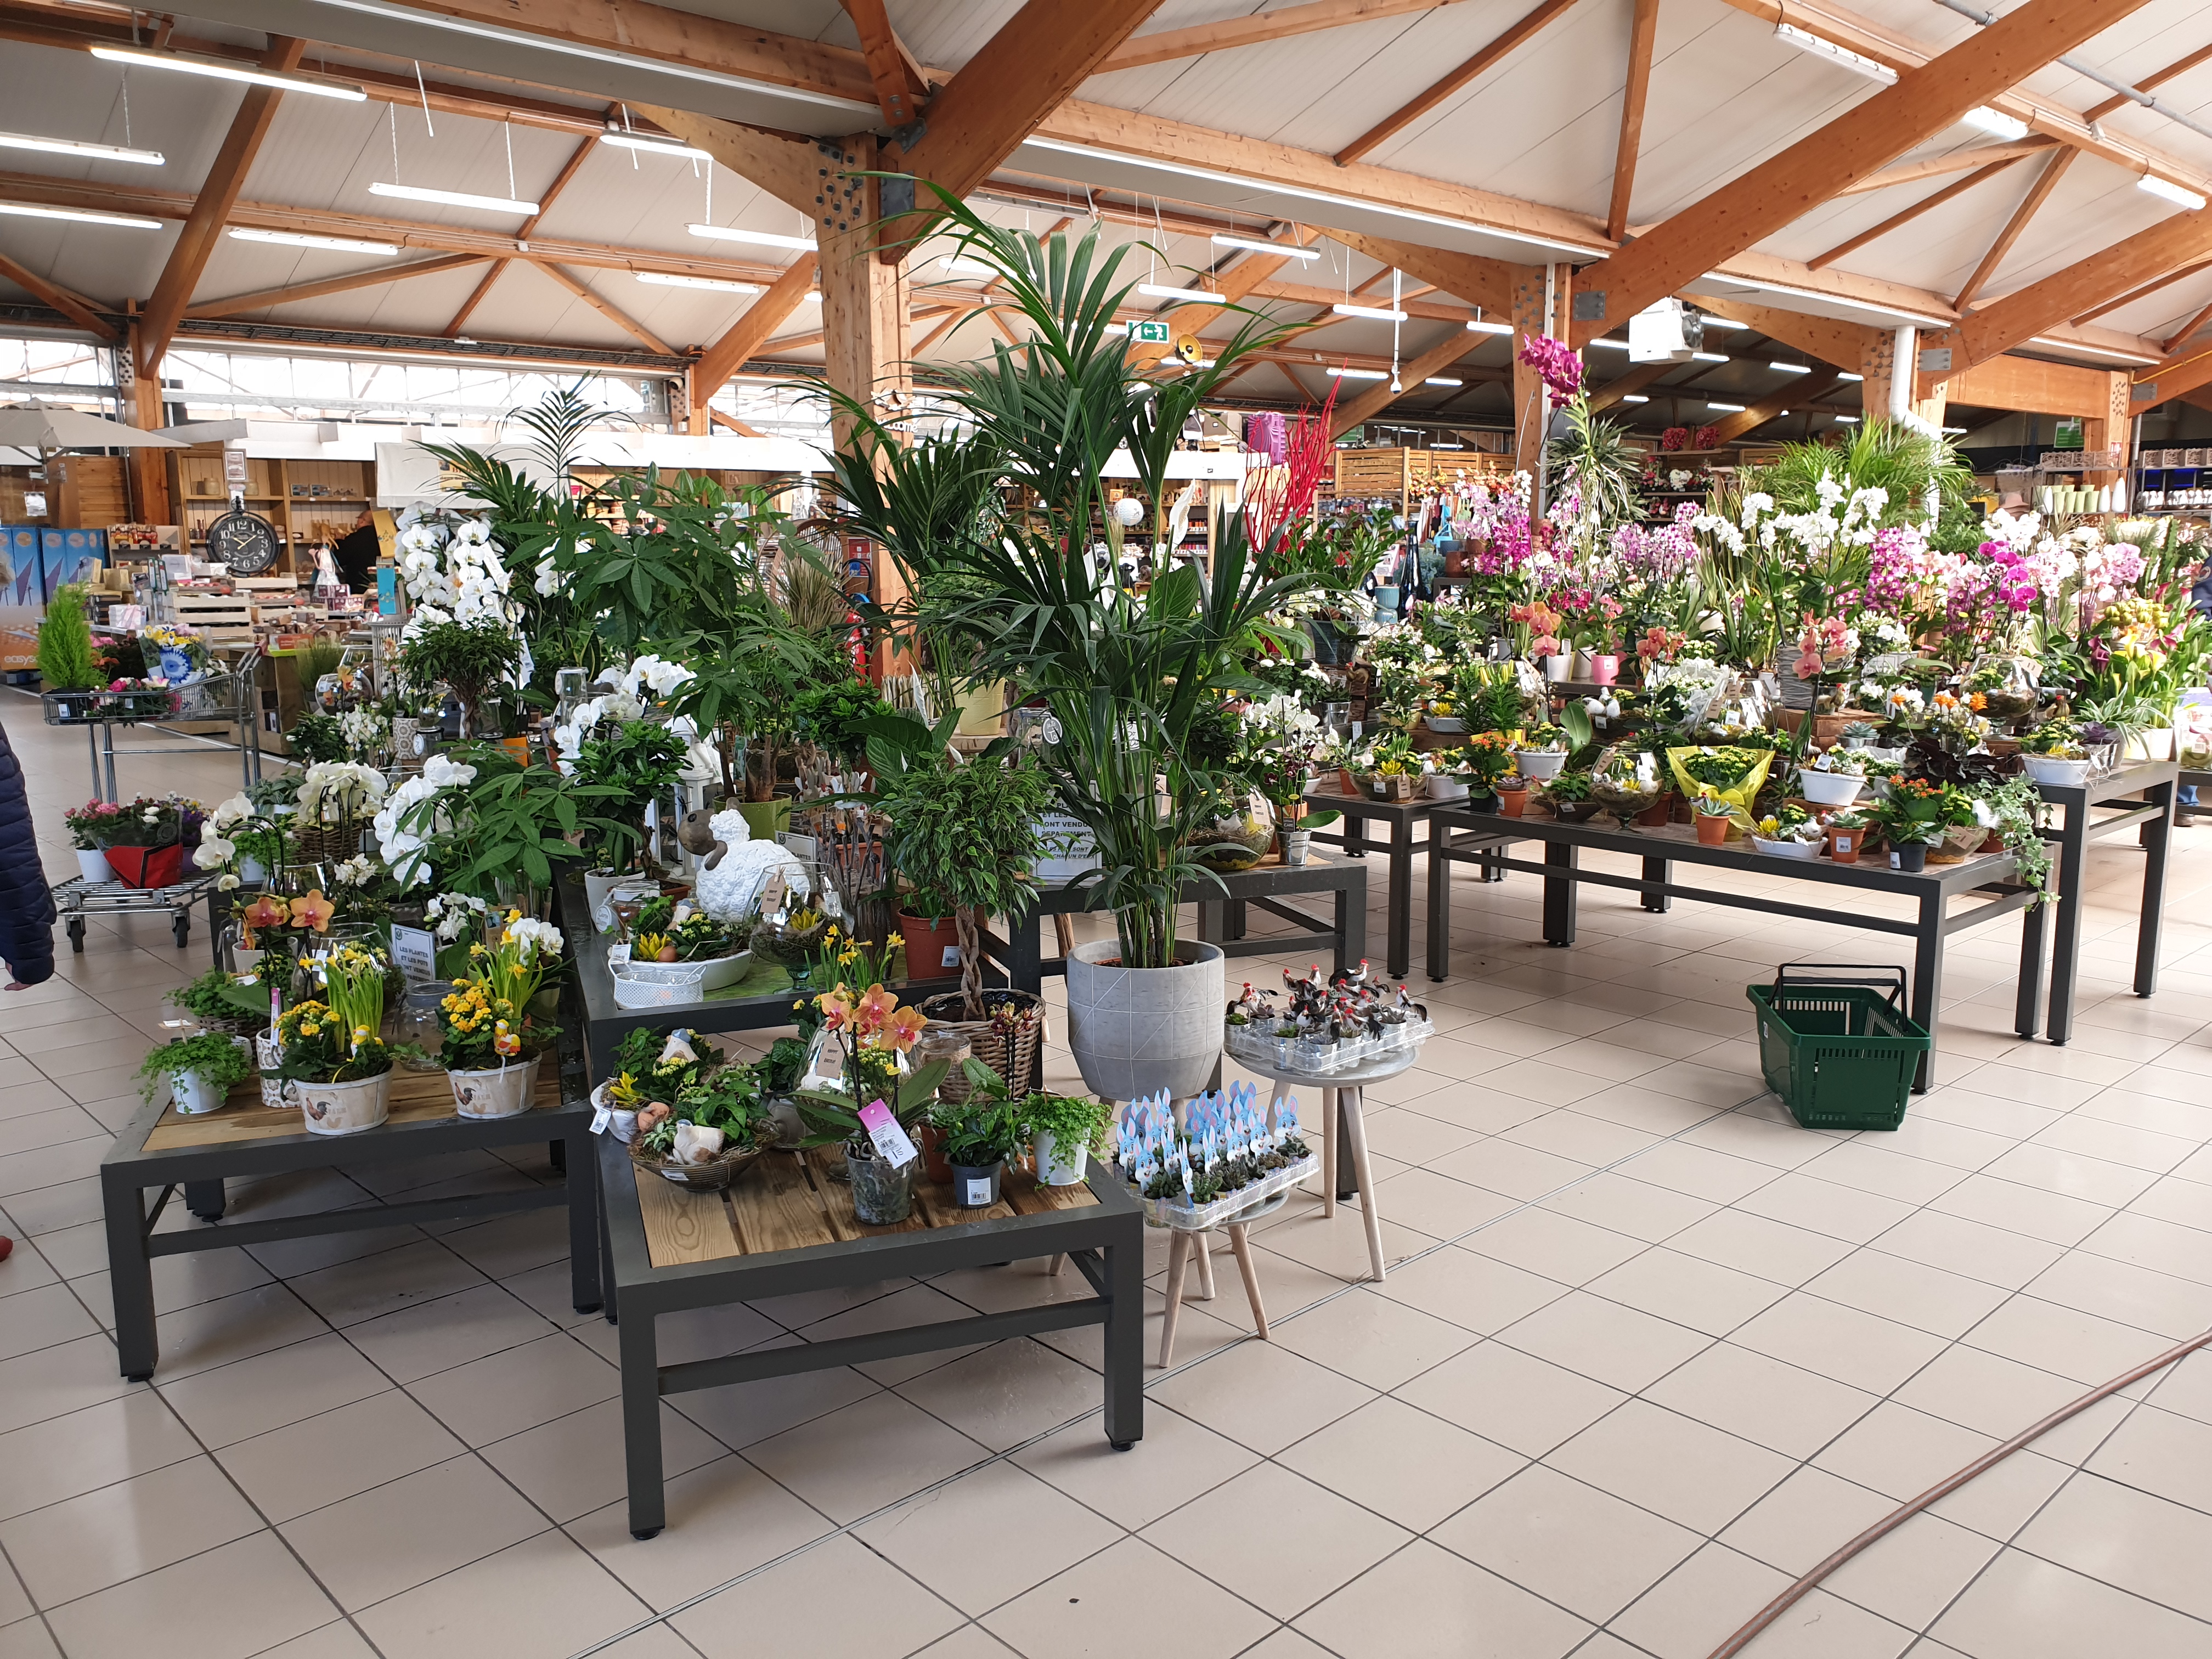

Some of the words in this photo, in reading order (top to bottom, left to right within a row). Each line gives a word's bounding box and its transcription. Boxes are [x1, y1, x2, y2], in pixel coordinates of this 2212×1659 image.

[228, 523, 235, 532] 11
[236, 520, 247, 529] 12
[251, 523, 255, 532] 1
[221, 529, 230, 539] 10
[257, 529, 264, 538] 2
[219, 540, 226, 549] 9
[261, 539, 268, 548] 3
[223, 550, 230, 558] 8
[258, 549, 266, 557] 4
[232, 557, 239, 566] 7
[243, 560, 250, 568] 6
[253, 556, 259, 565] 5
[4, 655, 38, 667] easys
[409, 948, 428, 958] PLANTES
